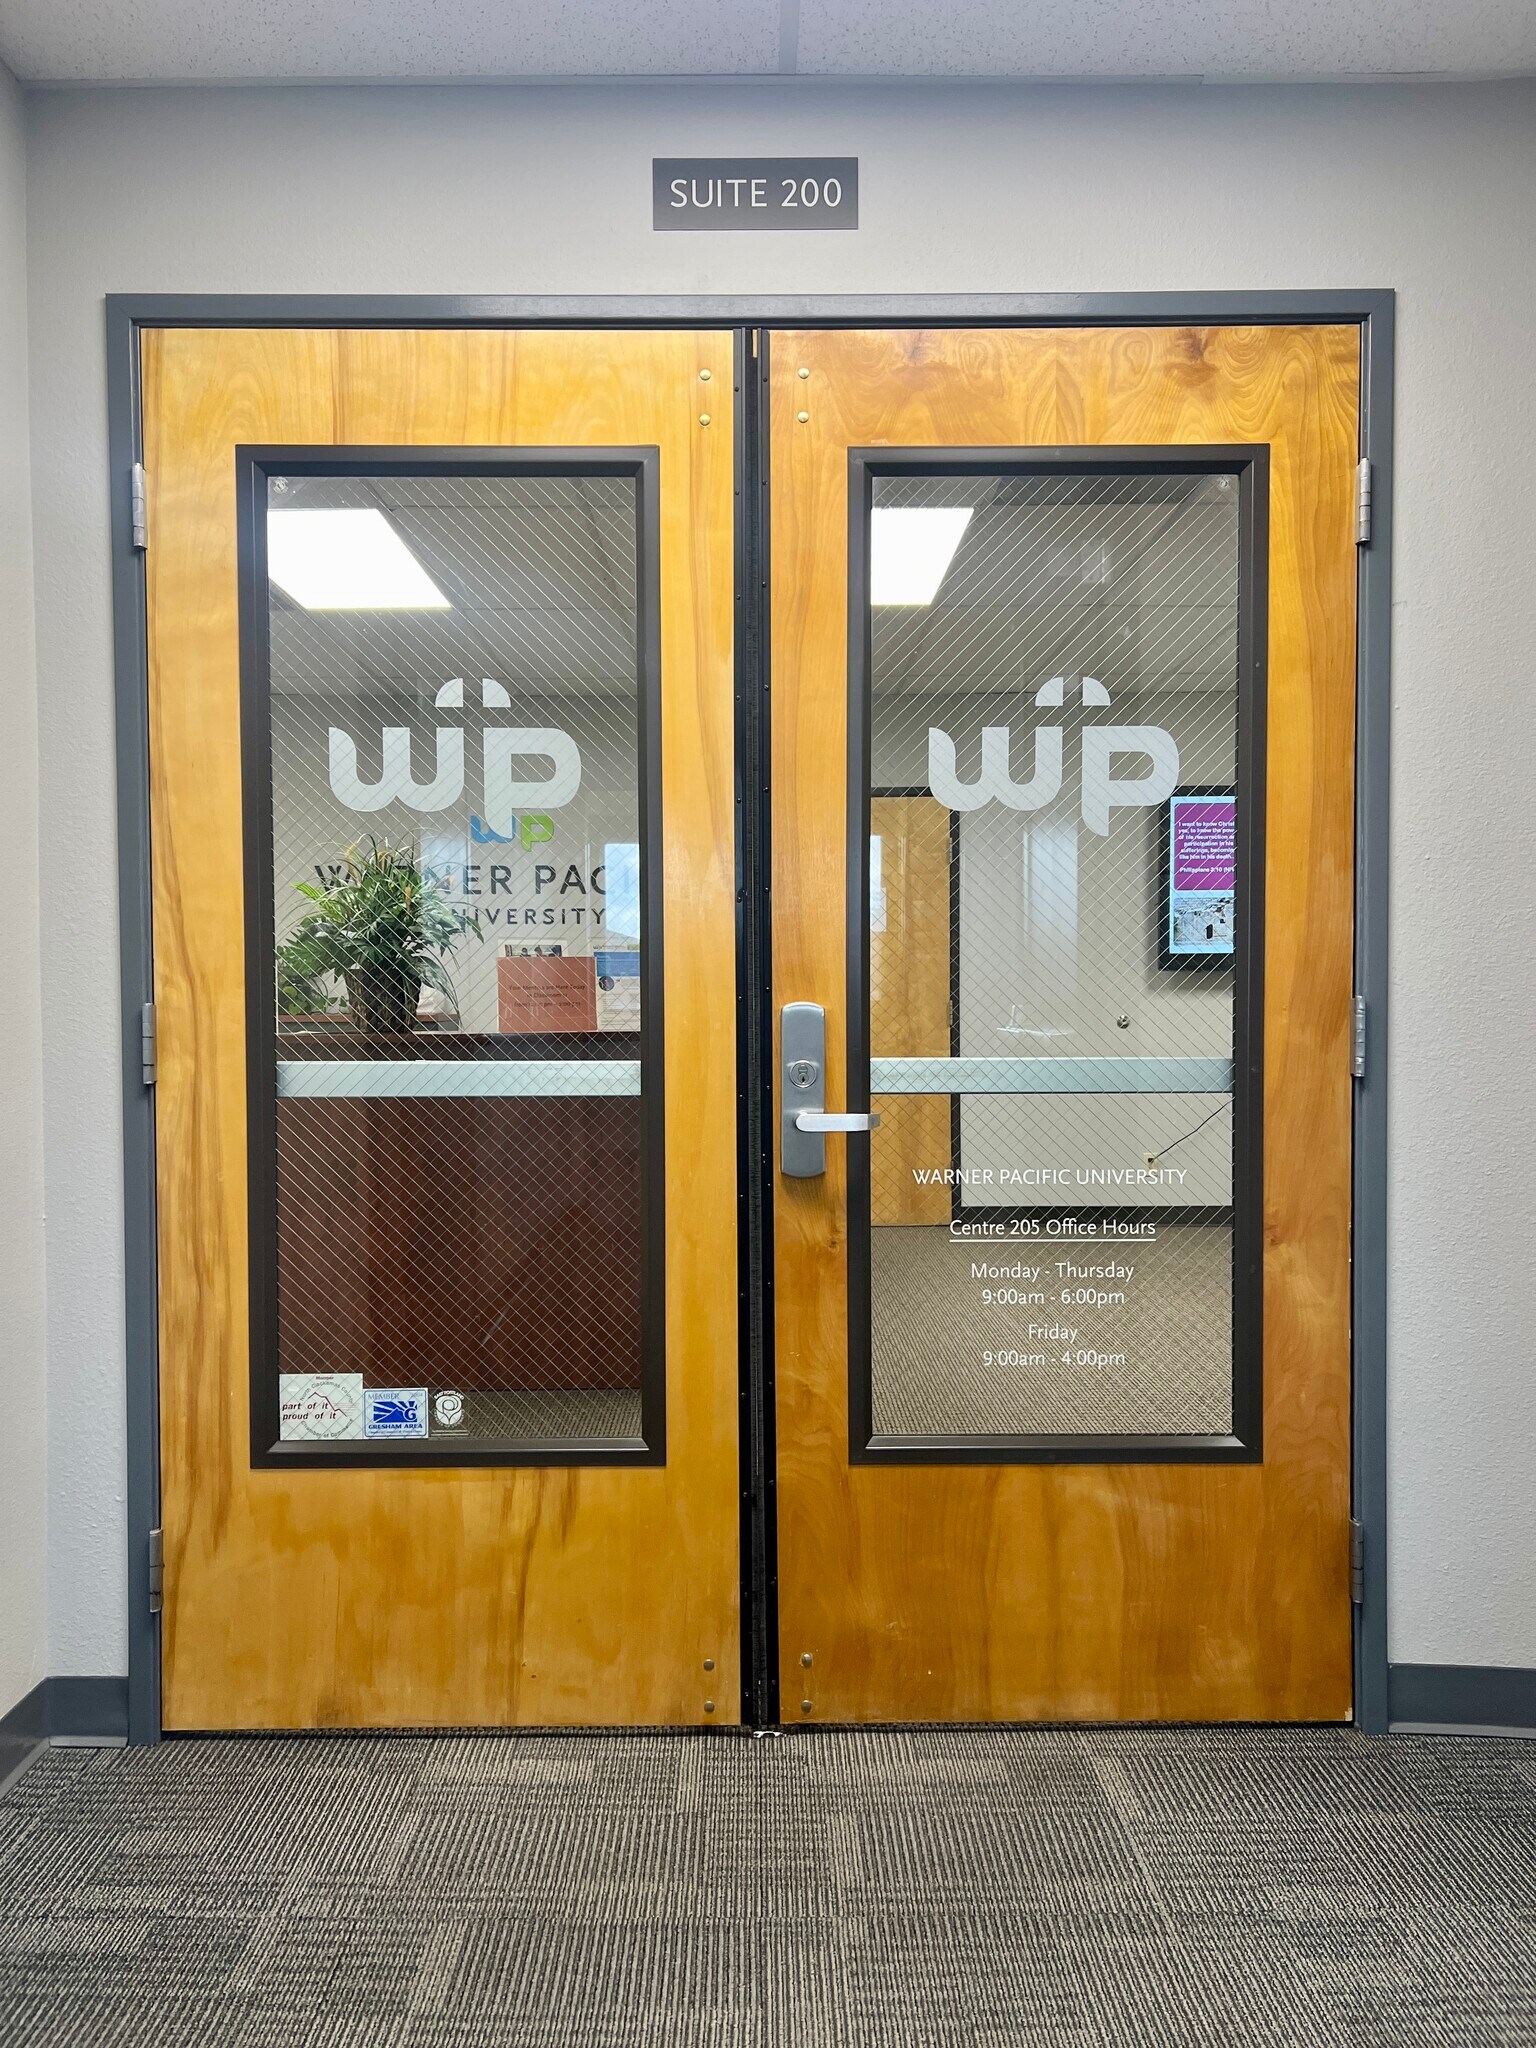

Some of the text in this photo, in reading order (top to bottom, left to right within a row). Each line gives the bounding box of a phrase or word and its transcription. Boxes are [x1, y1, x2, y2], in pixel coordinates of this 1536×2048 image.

[670, 178, 842, 208] SUITE 200
[912, 1169, 1188, 1185] WARNER PACIFIC UNIVERSITY
[949, 1219, 1156, 1236] Centre 205 Office Hours
[971, 1262, 1040, 1282] Monday
[1055, 1261, 1134, 1282] Thursday
[982, 1289, 1045, 1305] 9:00am
[1061, 1288, 1126, 1308] 6:00pm
[1028, 1323, 1078, 1344] Friday
[983, 1350, 1045, 1366] 9:00am
[1061, 1350, 1126, 1370] 4:00pm
[282, 1402, 302, 1411] part
[307, 1402, 317, 1410] of
[282, 1412, 309, 1421] proud
[314, 1412, 324, 1420] of
